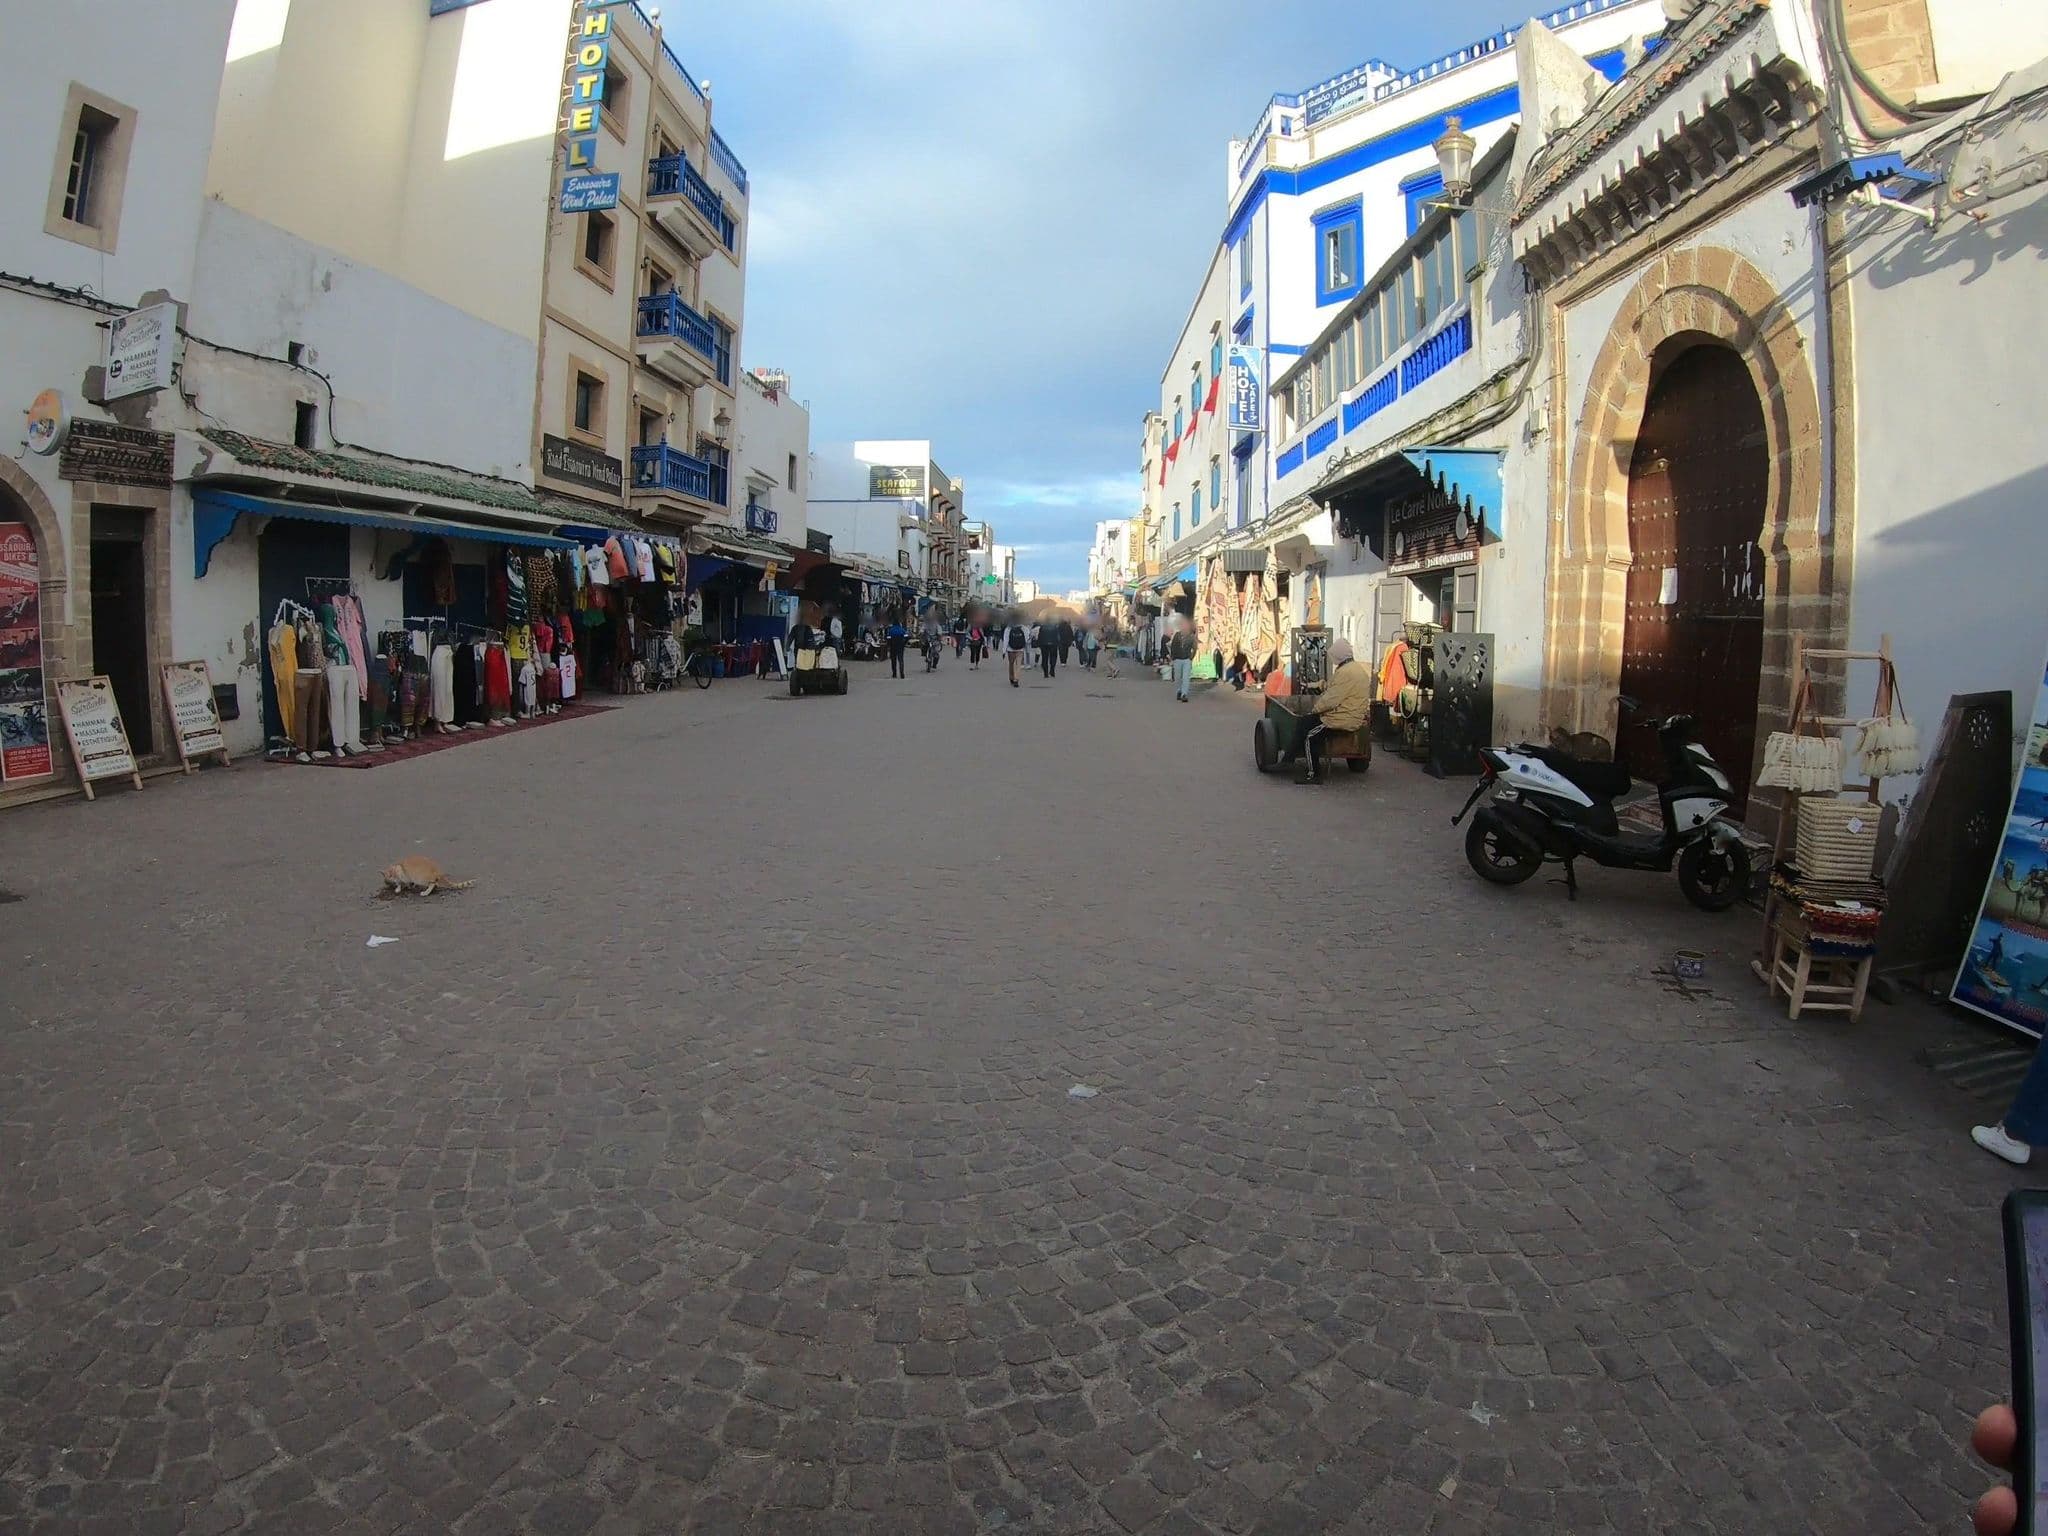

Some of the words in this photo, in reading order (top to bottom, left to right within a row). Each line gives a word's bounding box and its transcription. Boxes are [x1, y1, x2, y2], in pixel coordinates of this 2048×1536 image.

[569, 13, 608, 167] HOTEL
[567, 177, 612, 192] Essaouira
[562, 191, 586, 209] Wind
[586, 190, 615, 208] Palace
[1237, 366, 1250, 424] HOTEL
[877, 479, 918, 489] SEAFOOD
[519, 636, 526, 650] 9
[565, 664, 572, 678] 2
